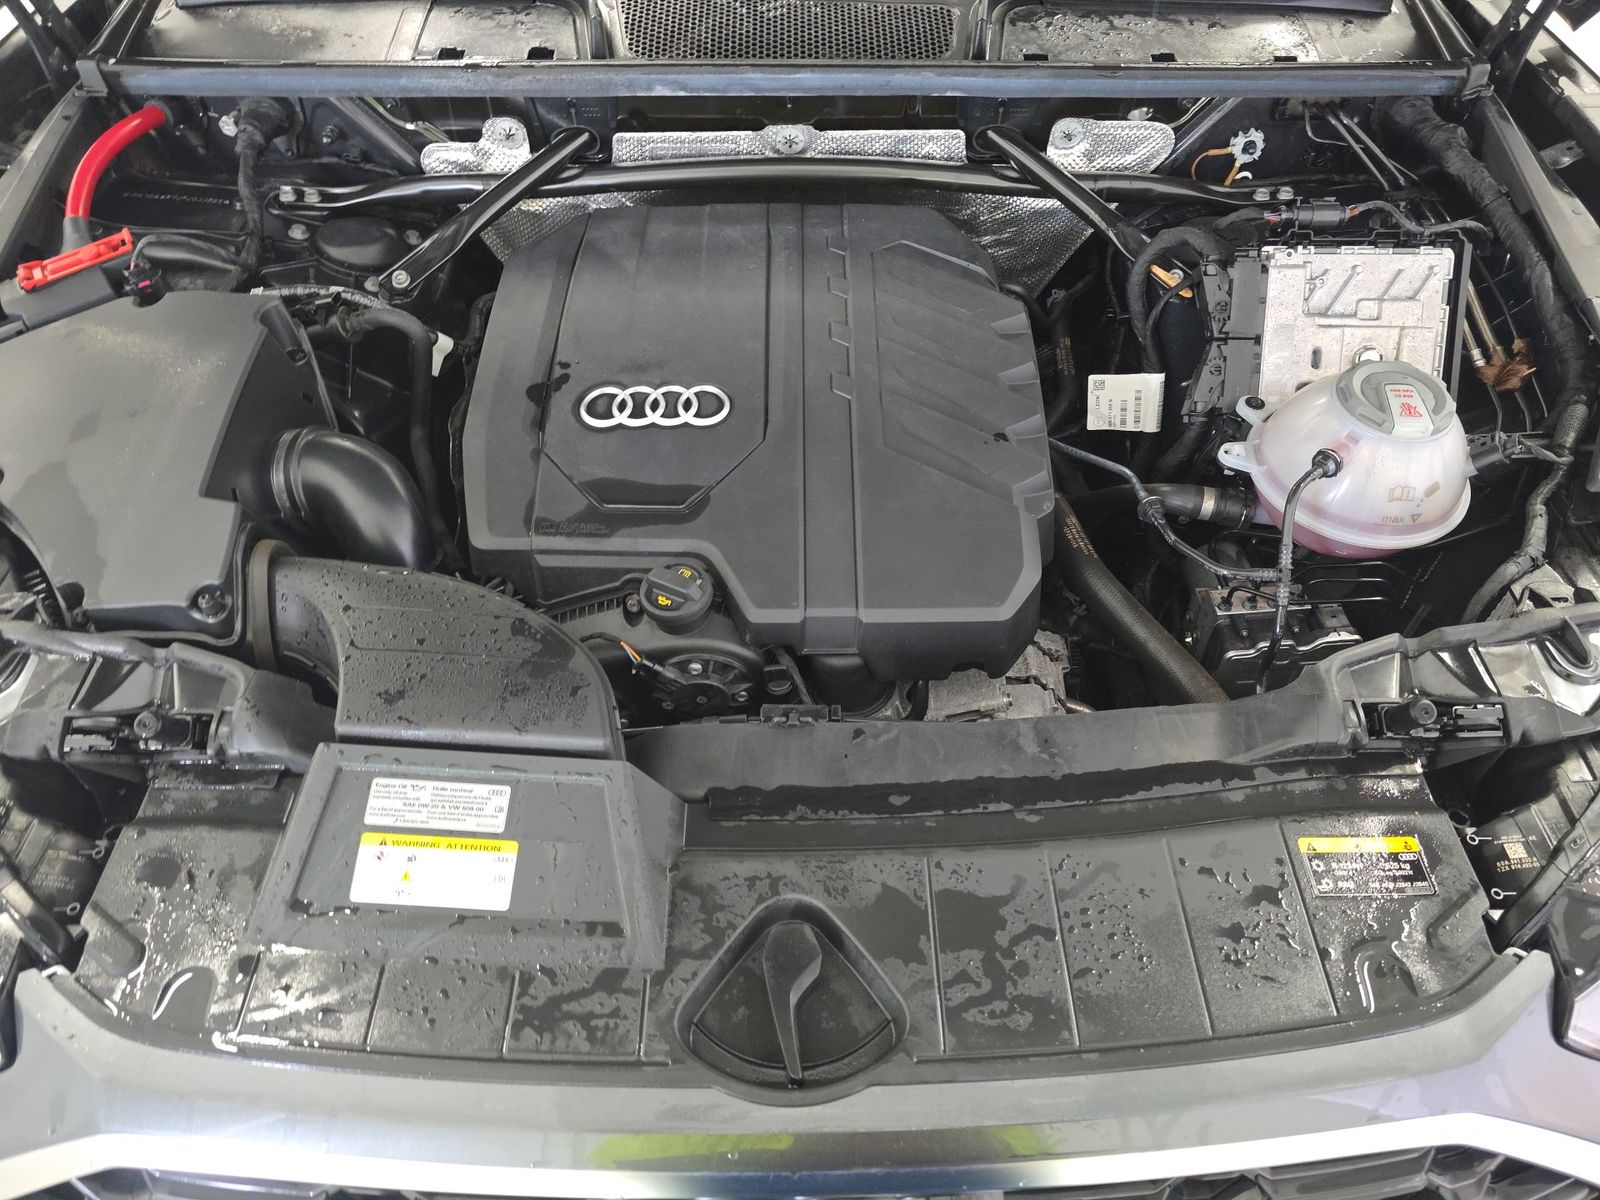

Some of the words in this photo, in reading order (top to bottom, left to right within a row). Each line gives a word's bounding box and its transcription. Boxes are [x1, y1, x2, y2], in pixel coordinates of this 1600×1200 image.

[1382, 515, 1405, 524] max
[391, 840, 440, 848] WARNING
[446, 842, 502, 852] ATTENTION
[1401, 862, 1411, 870] kg
